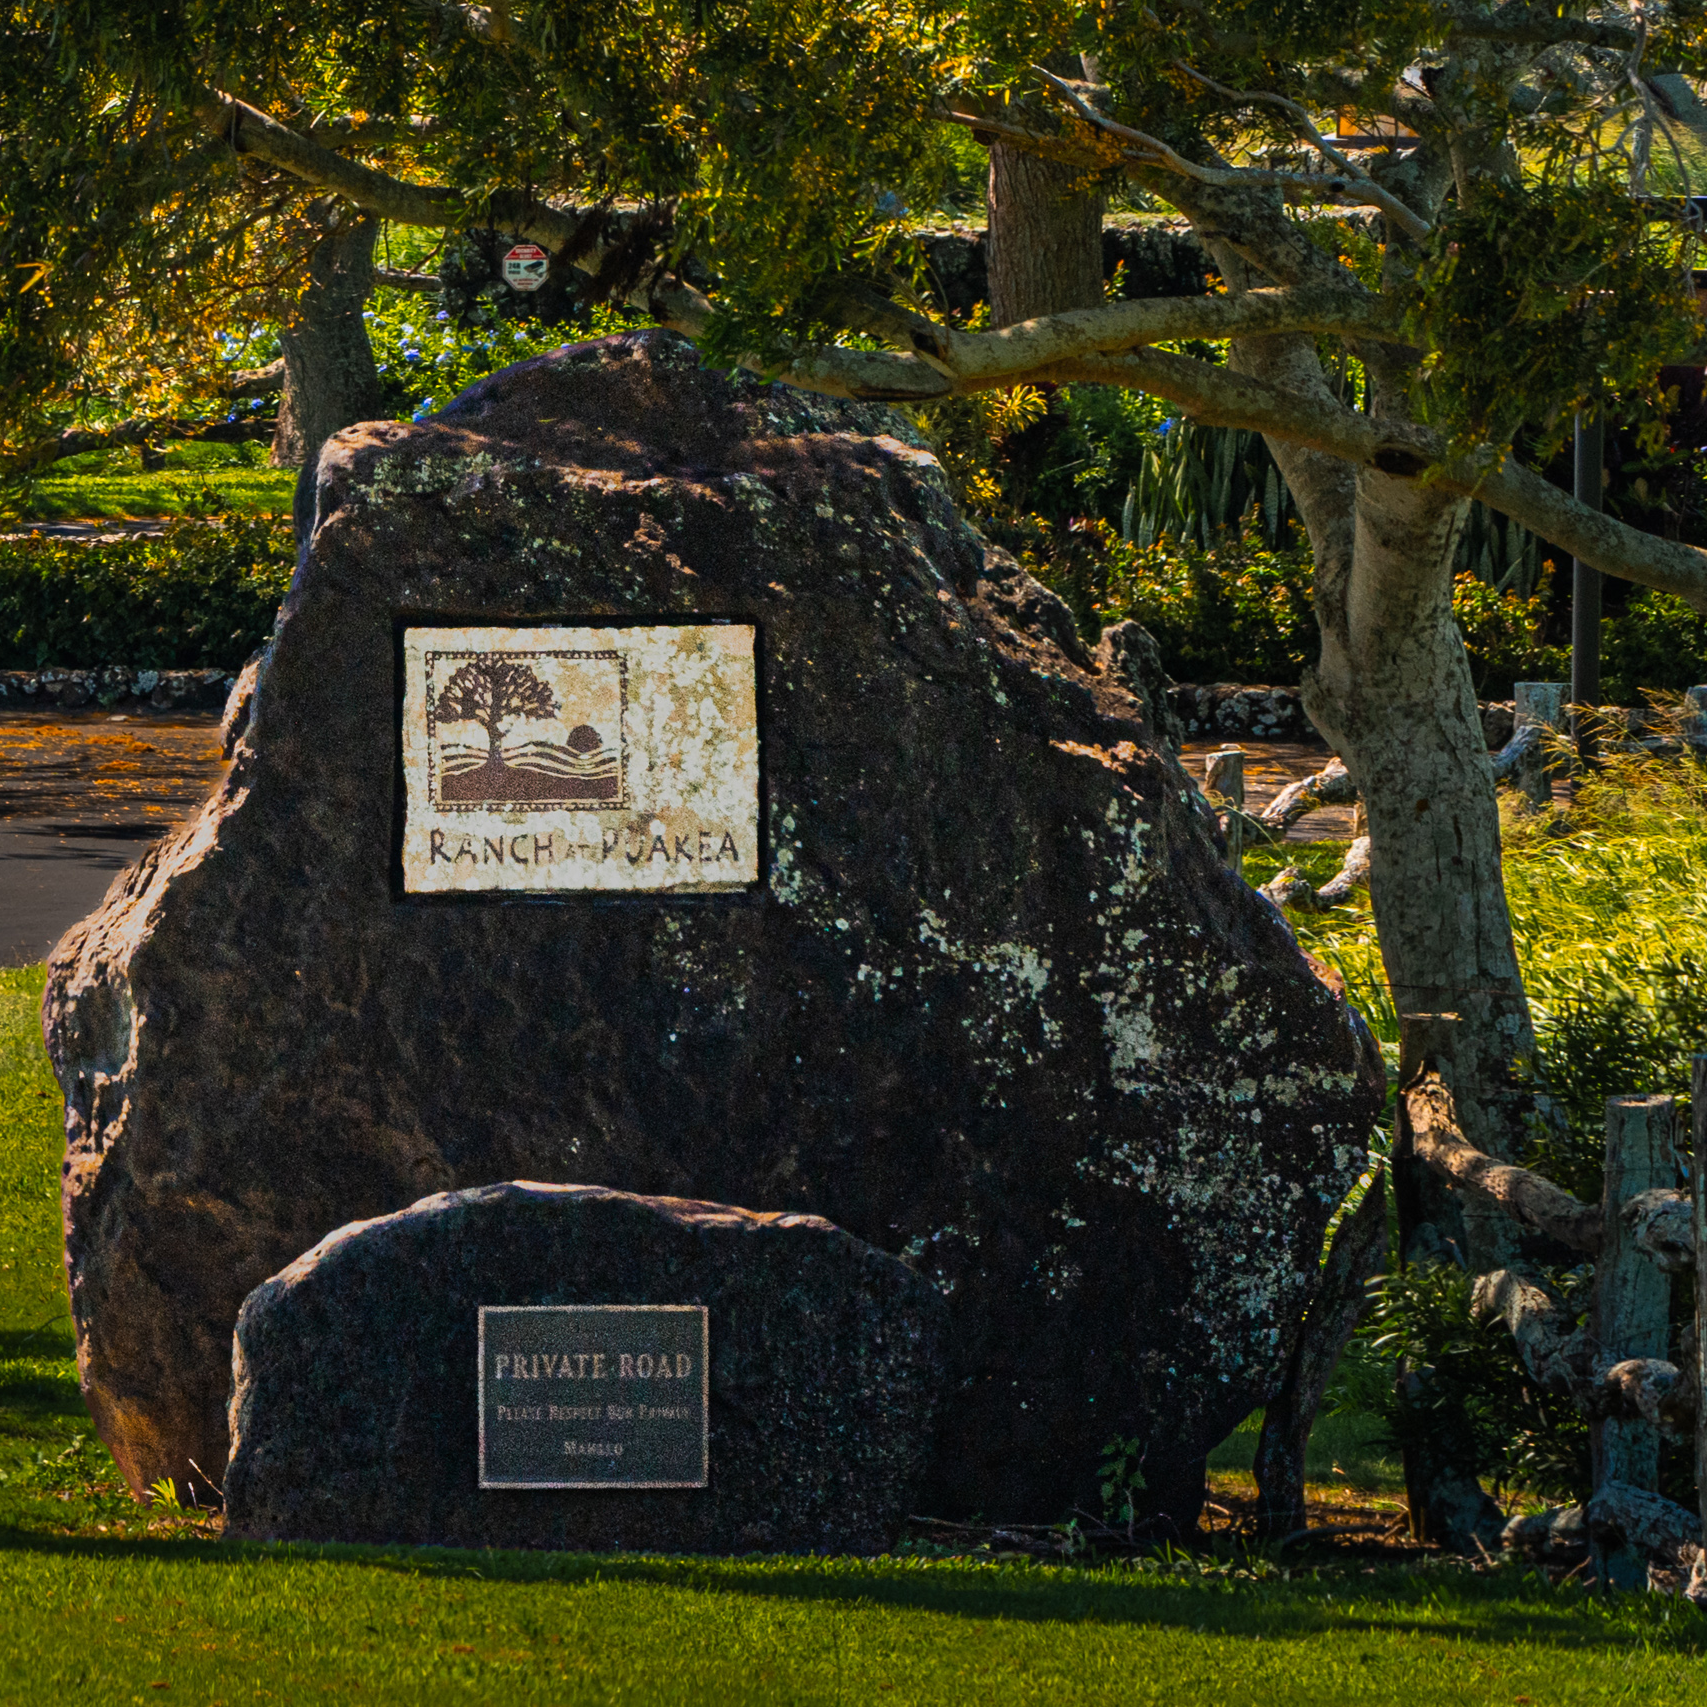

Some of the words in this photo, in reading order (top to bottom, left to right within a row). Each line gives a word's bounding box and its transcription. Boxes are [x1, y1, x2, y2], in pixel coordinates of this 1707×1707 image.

[430, 828, 554, 865] RANCH
[602, 827, 739, 864] PUAKEA
[495, 1353, 608, 1380] PRIVATE
[619, 1353, 692, 1380] ROAD
